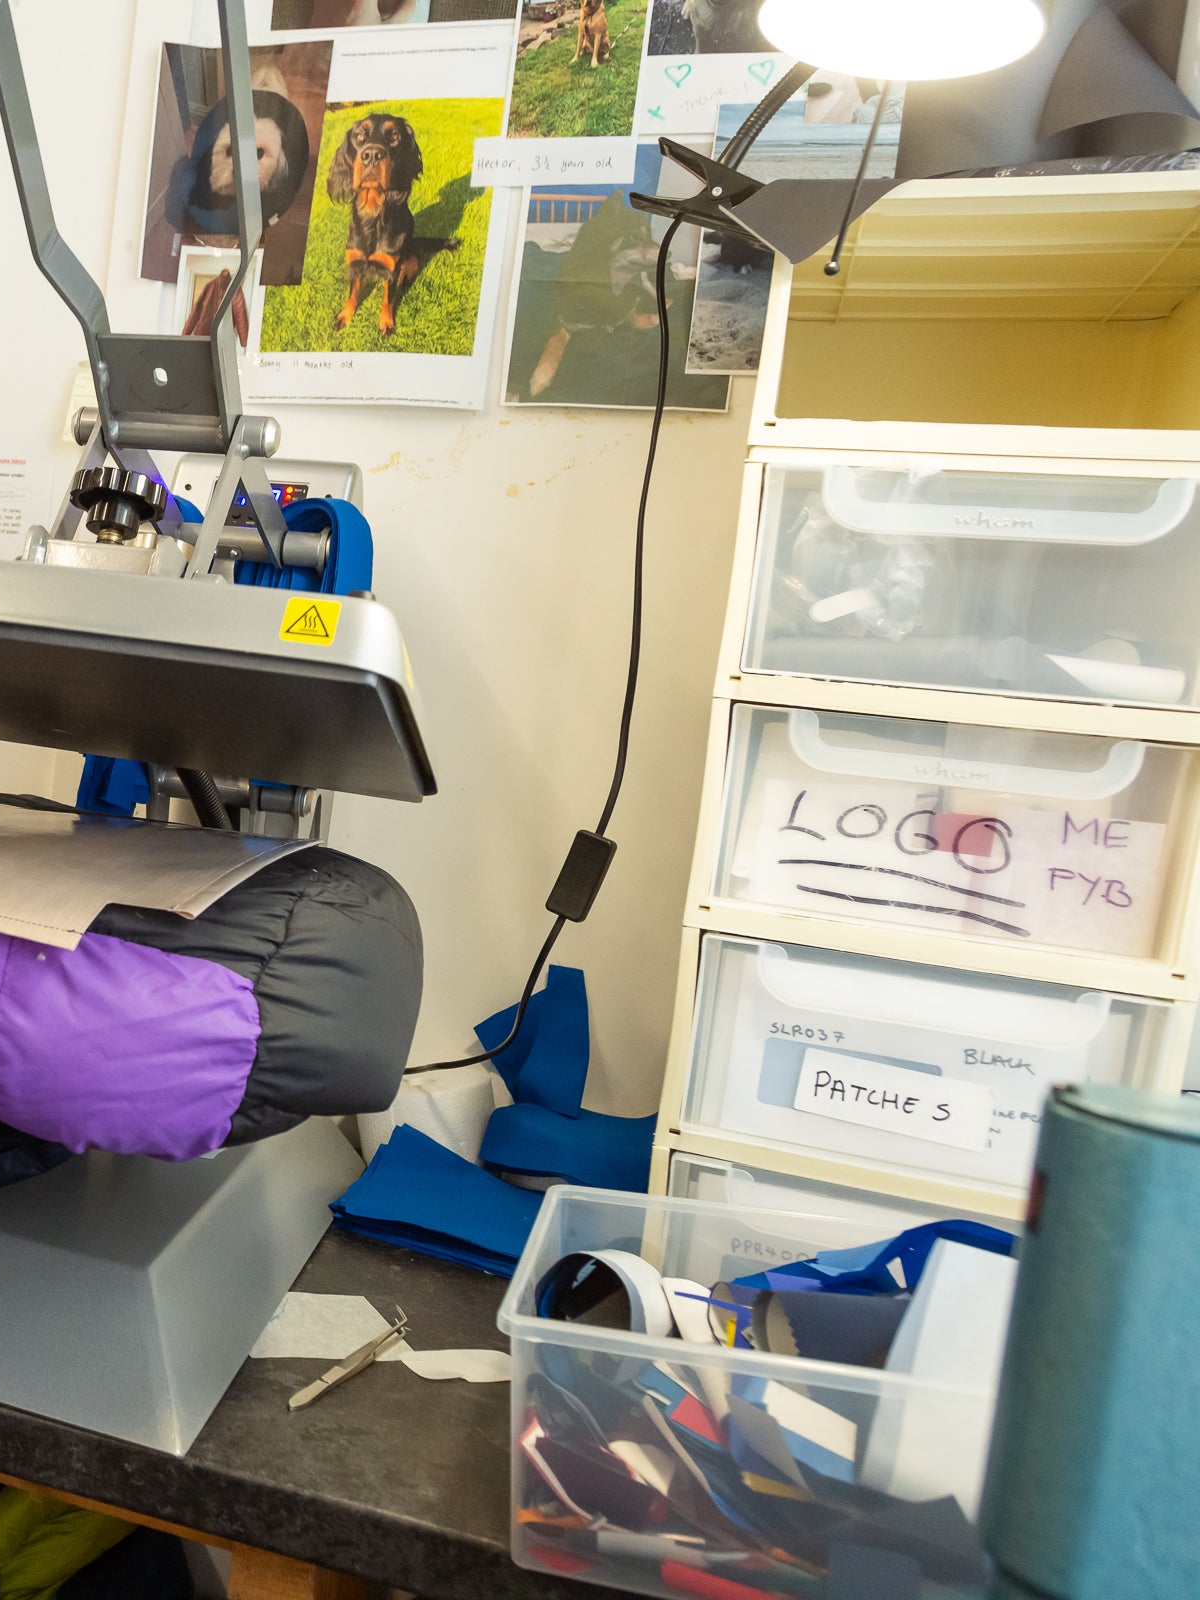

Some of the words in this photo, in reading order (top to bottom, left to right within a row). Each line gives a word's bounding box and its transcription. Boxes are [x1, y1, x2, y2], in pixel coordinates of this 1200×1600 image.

[595, 156, 614, 170] old
[954, 508, 1035, 529] wham
[913, 761, 991, 783] wham
[779, 789, 1013, 875] LOGO
[1061, 810, 1131, 848] ME
[962, 1047, 1037, 1077] BLACK
